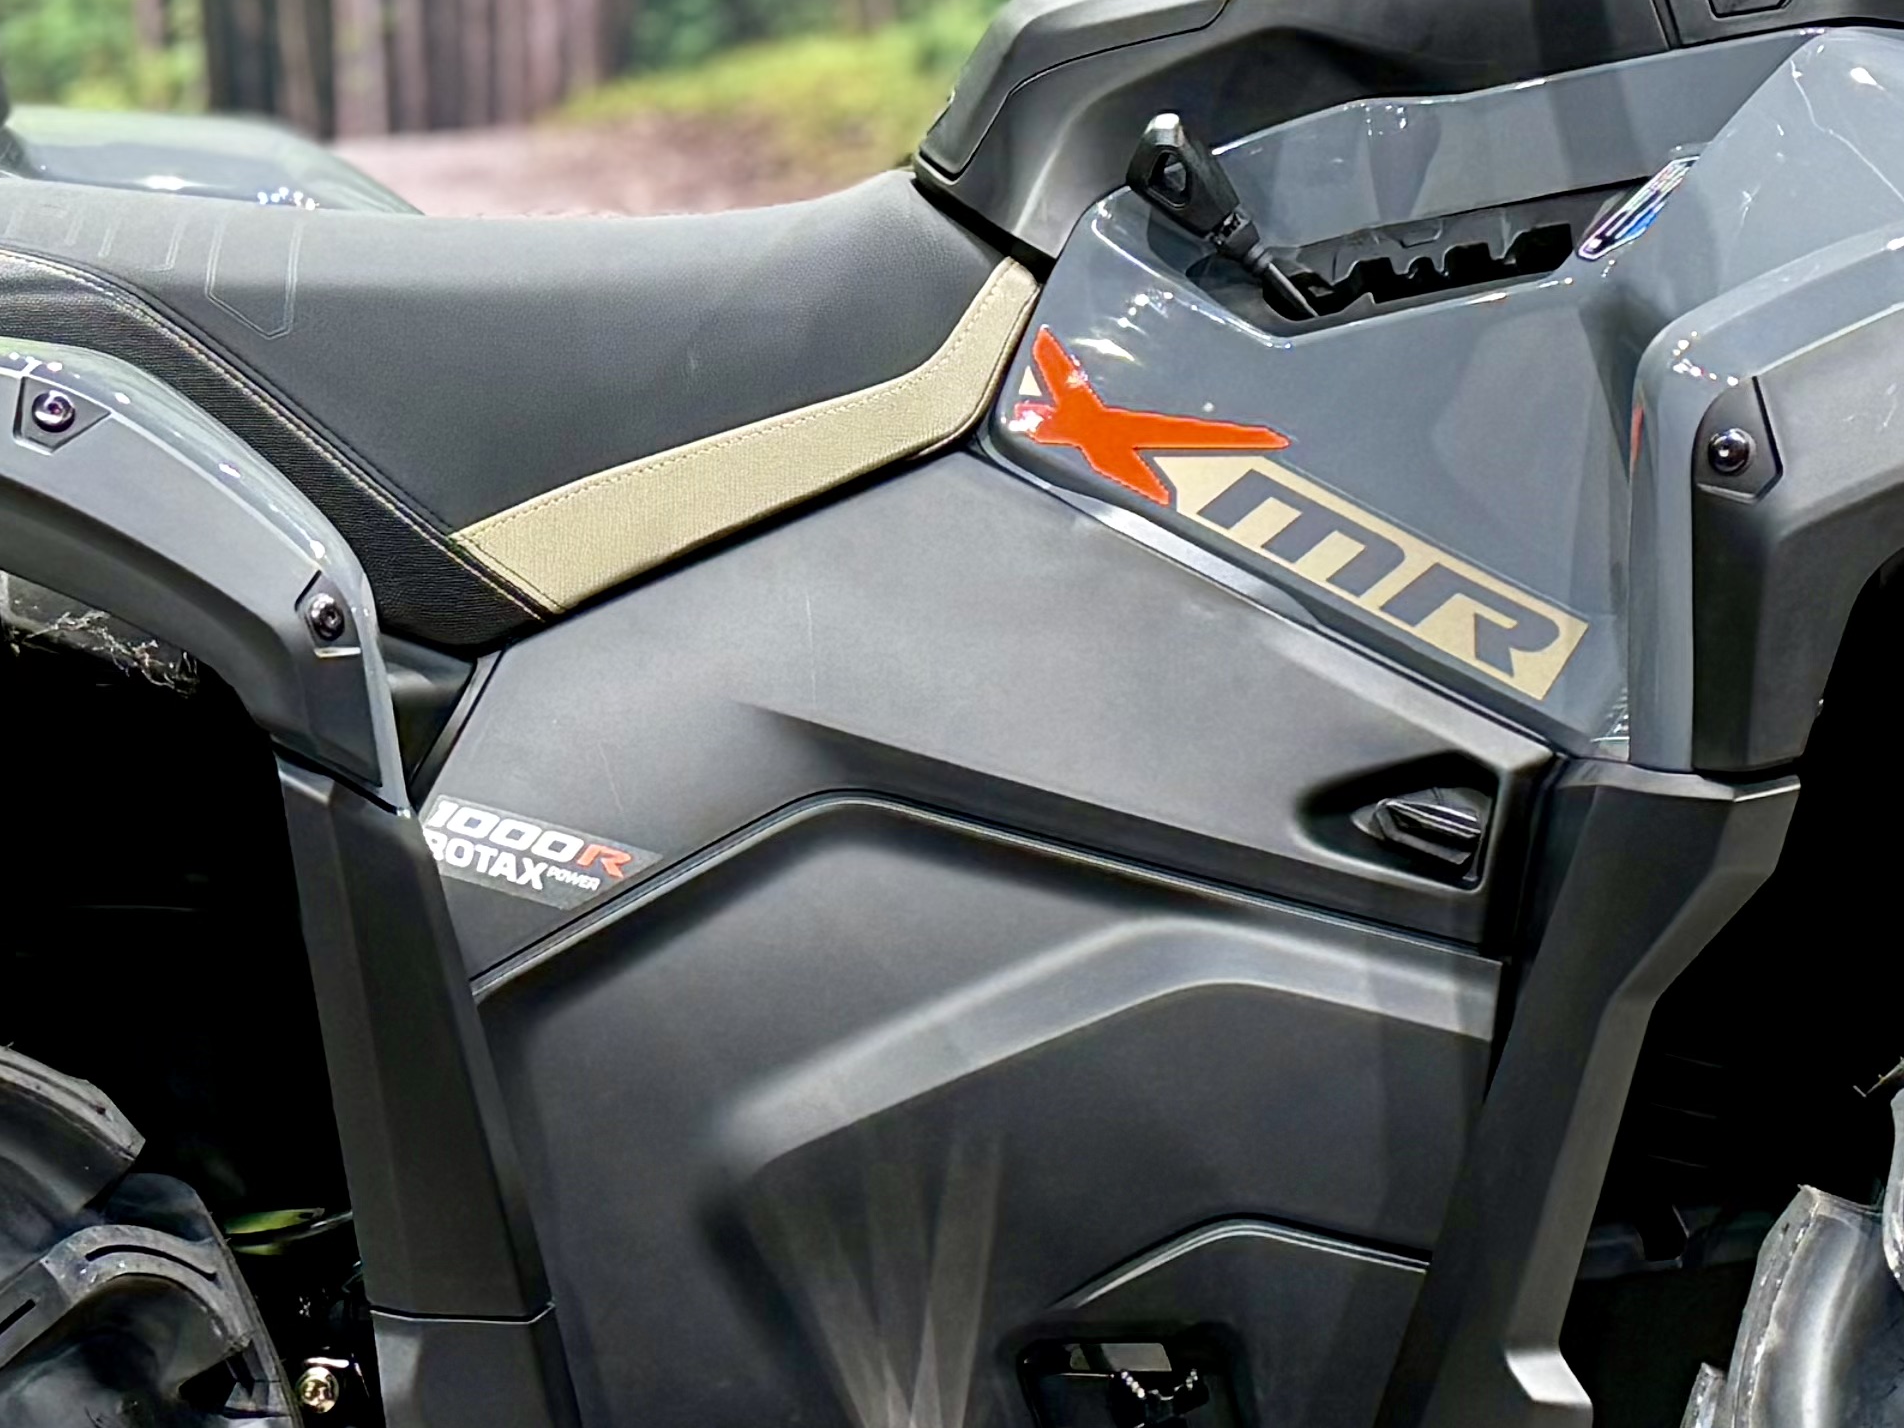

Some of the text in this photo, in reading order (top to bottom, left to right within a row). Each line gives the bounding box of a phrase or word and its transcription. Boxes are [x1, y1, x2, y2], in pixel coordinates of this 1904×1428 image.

[423, 828, 601, 891] ROTAX POWER
[426, 799, 632, 880] 1000R
